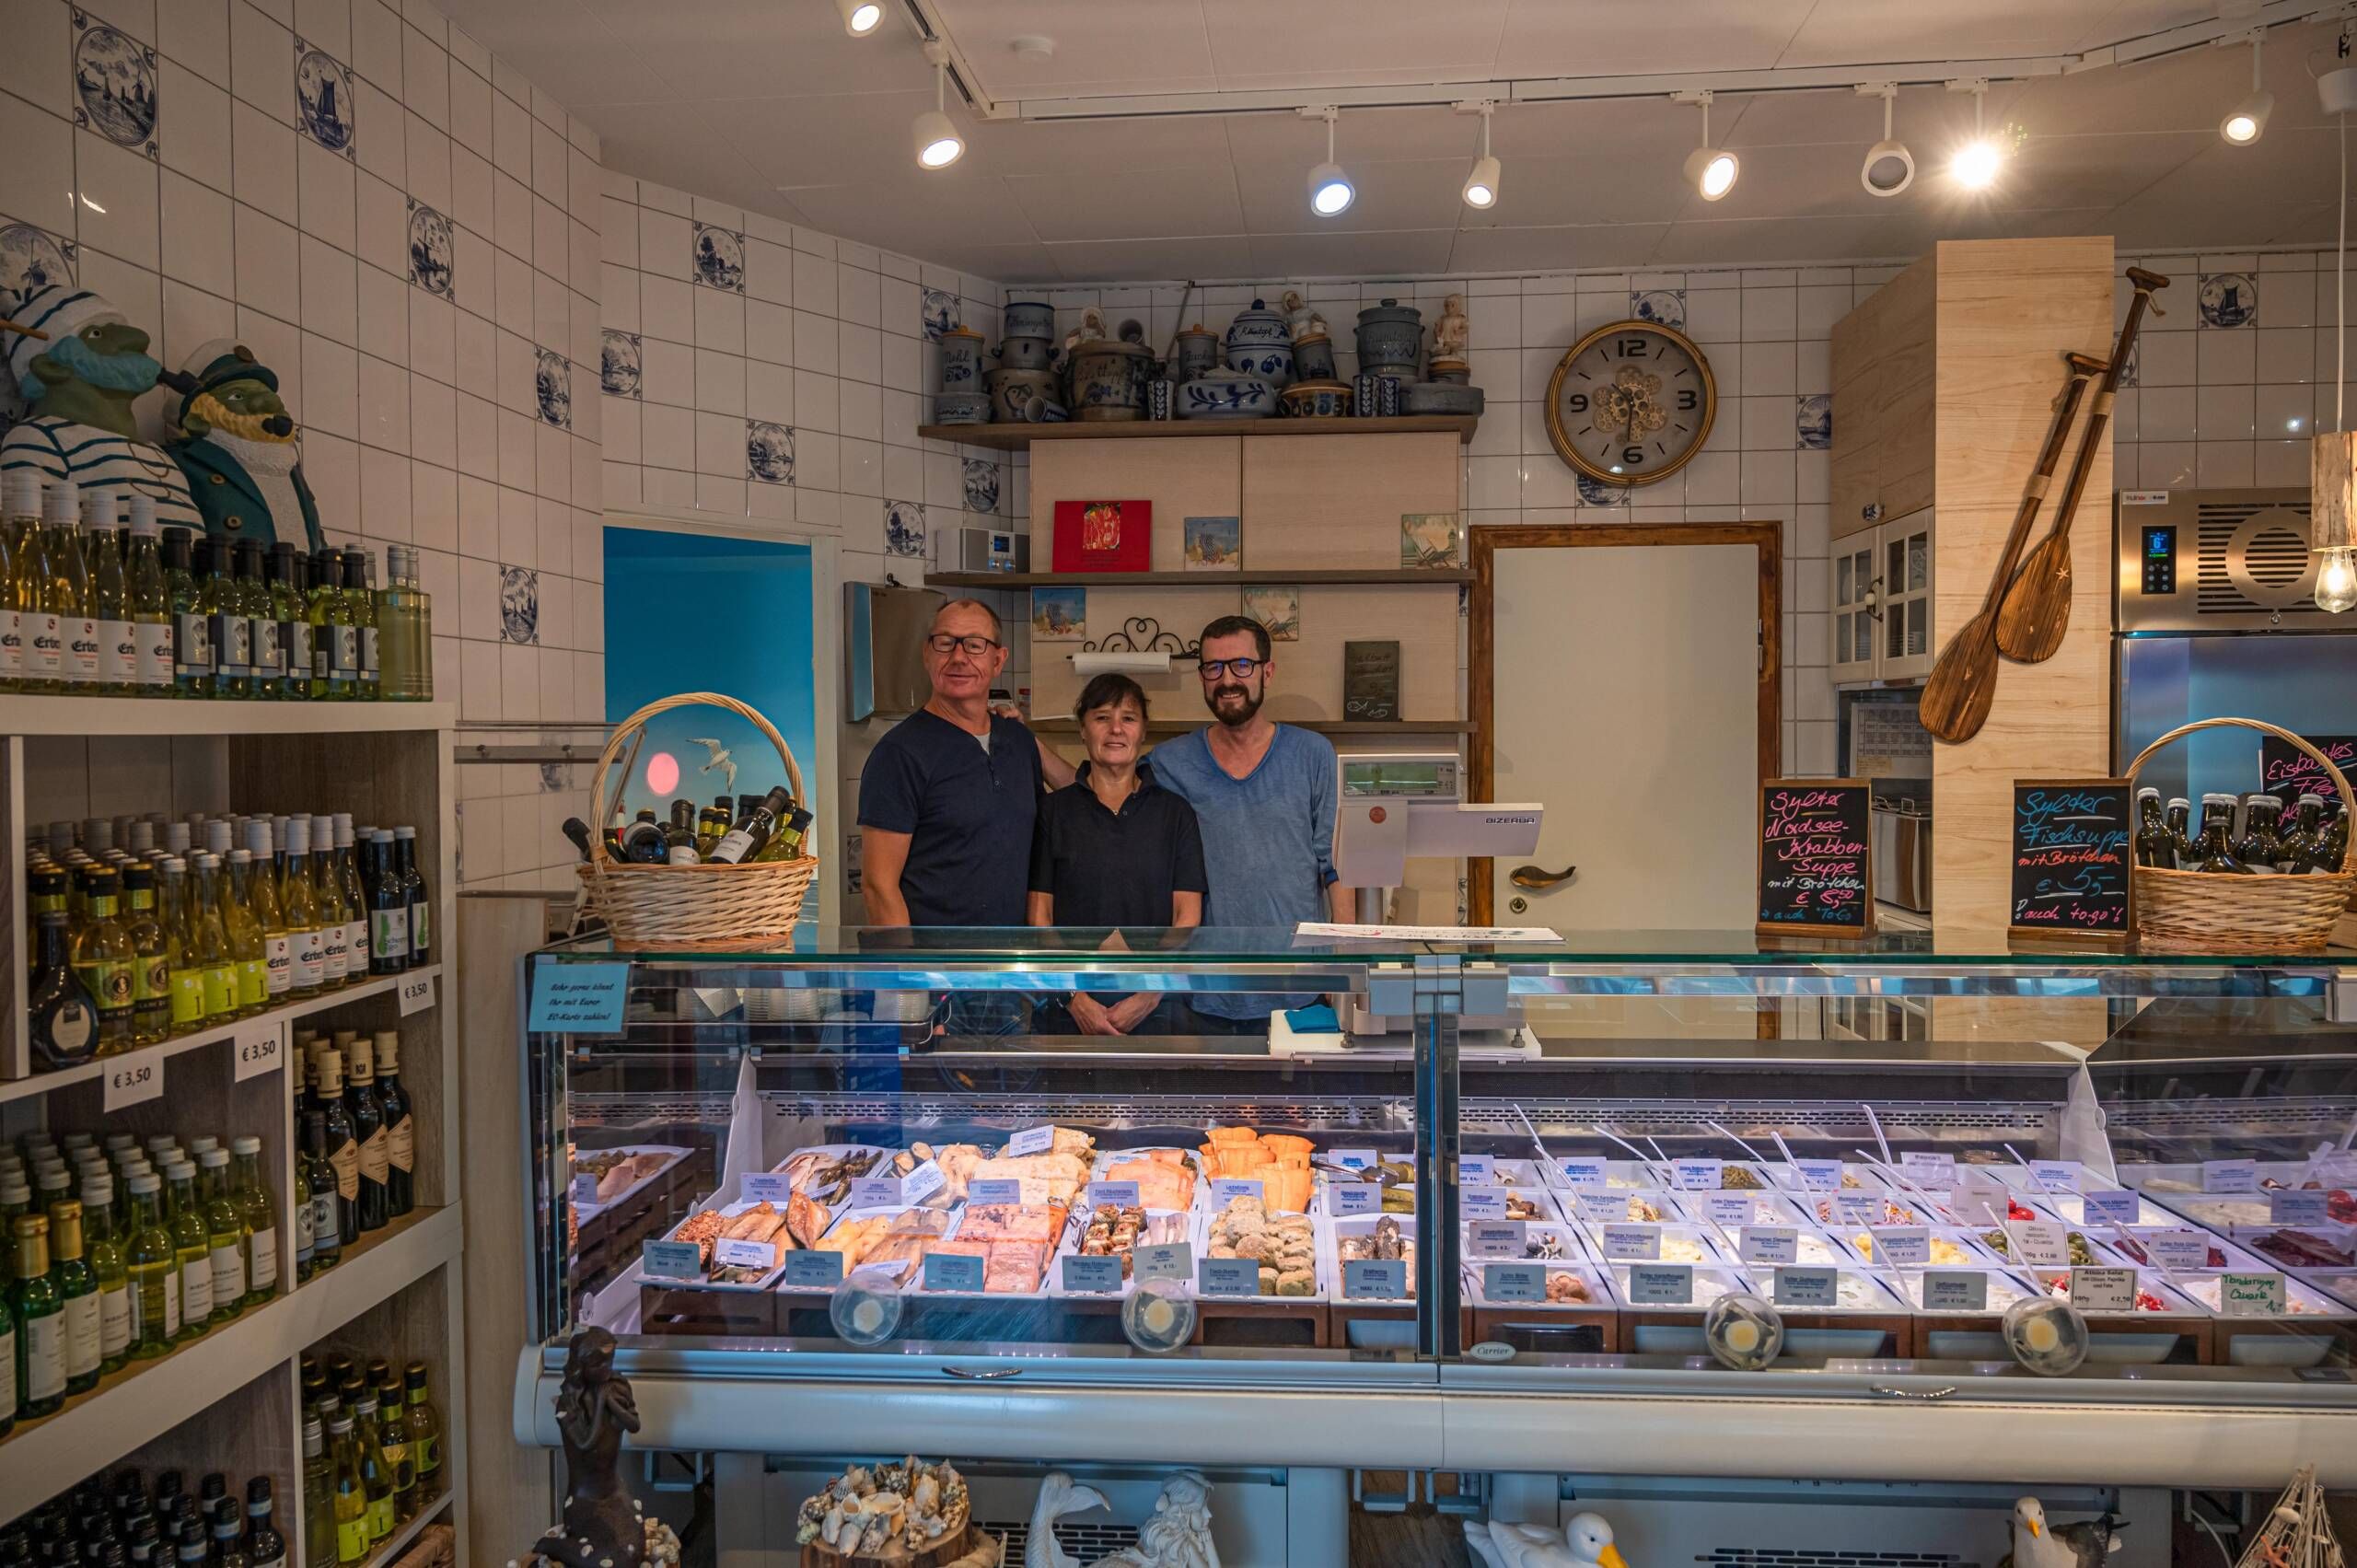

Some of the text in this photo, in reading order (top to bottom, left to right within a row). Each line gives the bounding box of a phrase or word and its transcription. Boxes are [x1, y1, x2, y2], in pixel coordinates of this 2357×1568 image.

[1618, 339, 1647, 357] 12
[1569, 394, 1588, 412] 9
[1677, 389, 1697, 410] 3
[1622, 446, 1643, 464] 6
[1771, 790, 1845, 819] Sylter
[2017, 791, 2117, 826] Sylter
[1484, 817, 1536, 825] BIZERBA
[1766, 818, 1850, 838] Nordsee-
[1778, 839, 1868, 860] Krabben-
[1792, 858, 1858, 879] Suppe
[2018, 854, 2048, 867] mit
[1767, 877, 1795, 889] mit
[2036, 878, 2052, 893] €
[1795, 891, 1811, 905] €
[405, 982, 428, 999] € 3,50
[242, 1040, 276, 1062] € 3,50
[114, 1067, 151, 1088] € 3,50
[1476, 1346, 1511, 1355] Carrier
